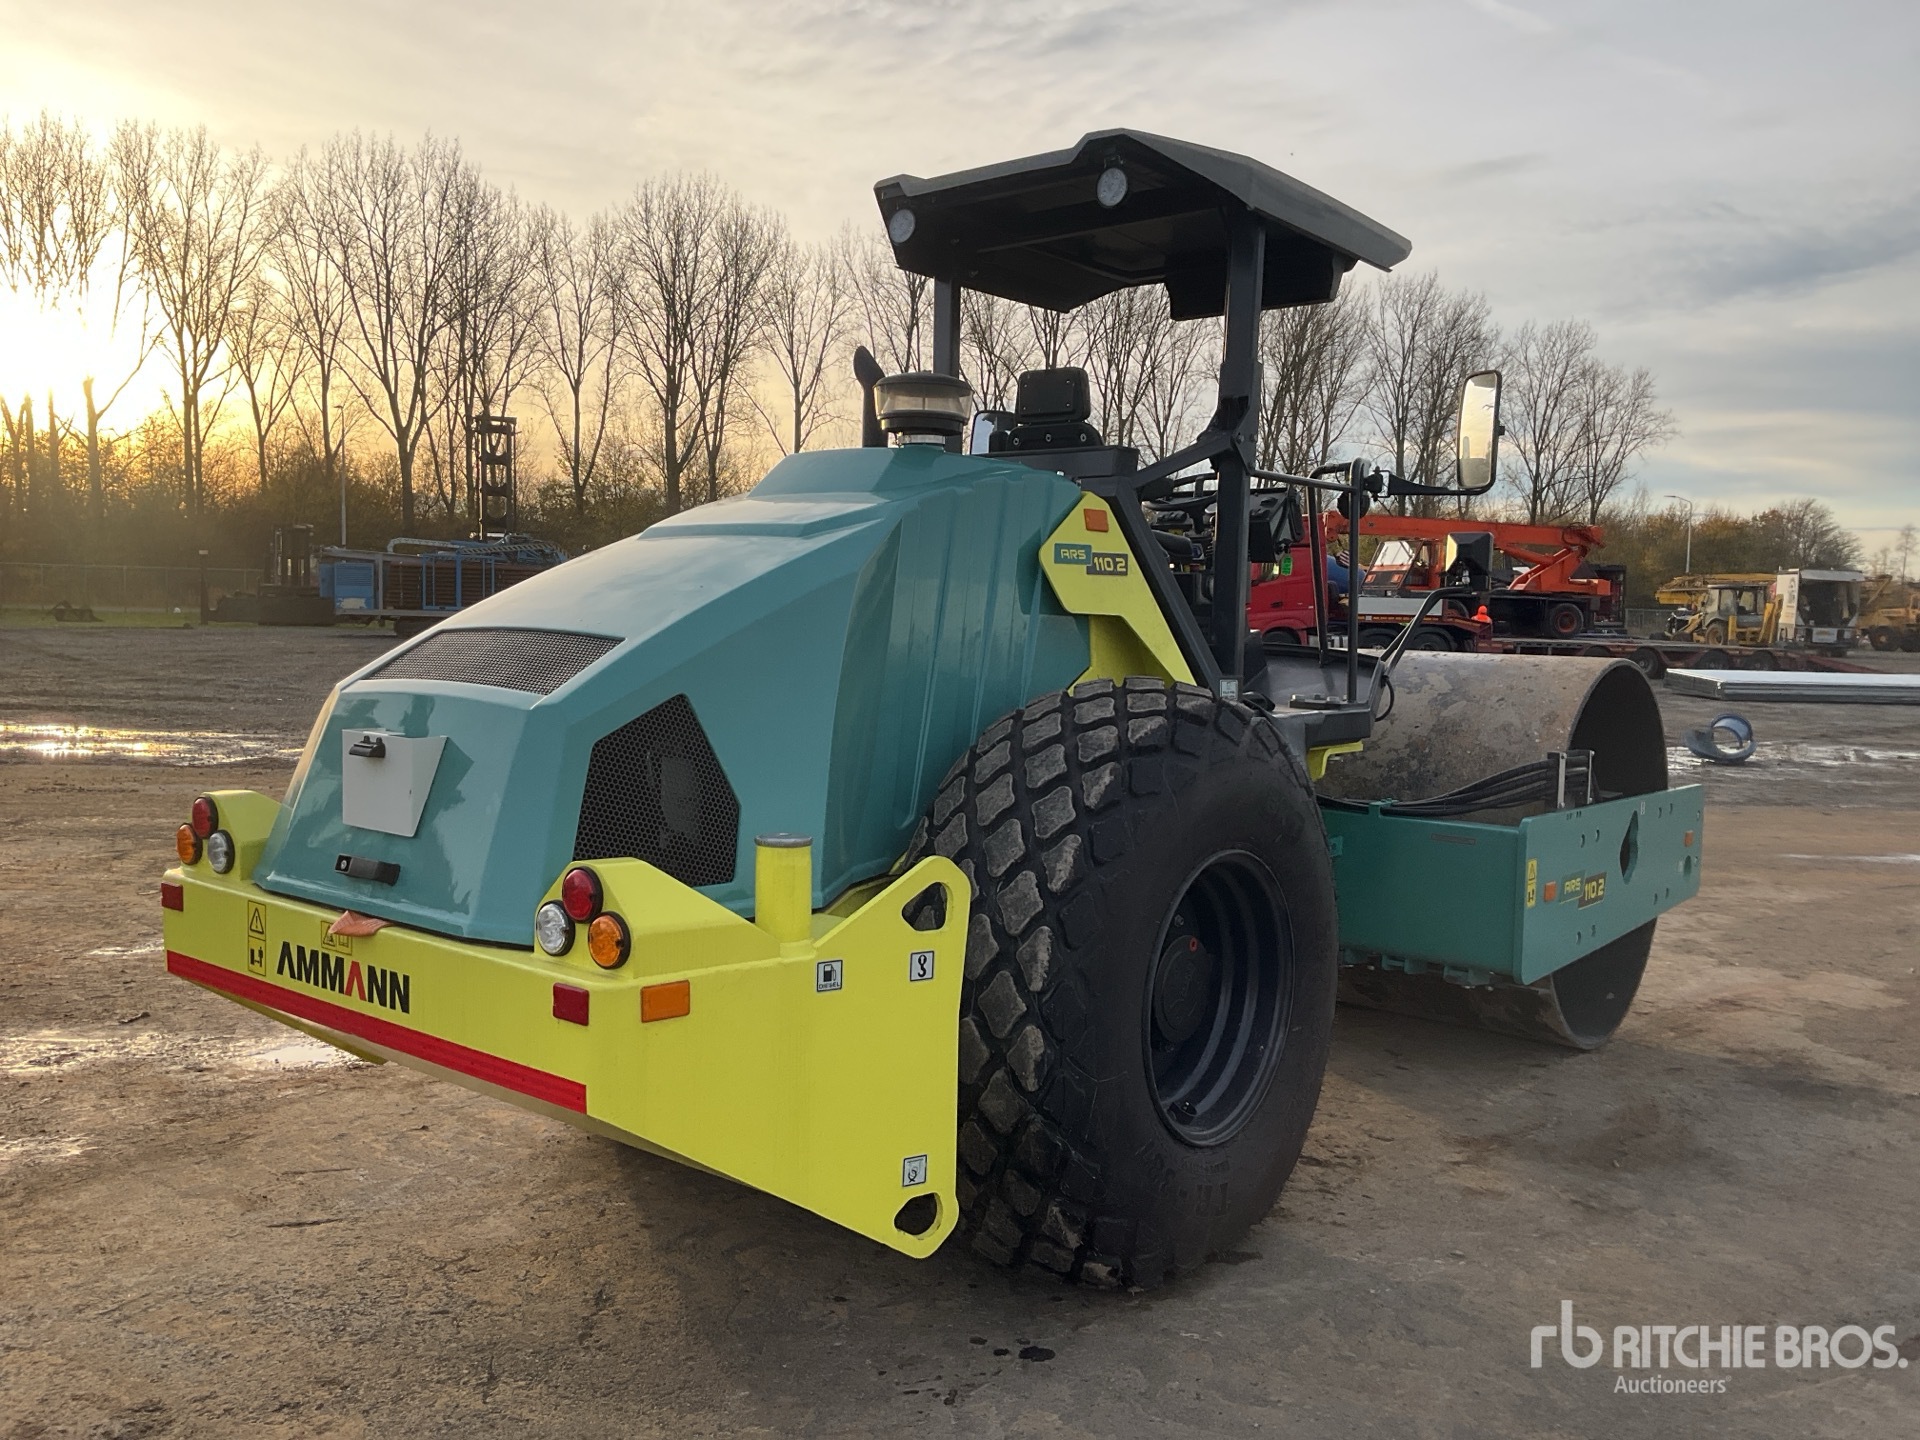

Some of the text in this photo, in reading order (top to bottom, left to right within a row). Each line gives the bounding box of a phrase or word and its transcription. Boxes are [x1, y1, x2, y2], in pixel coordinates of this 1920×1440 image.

[1060, 548, 1086, 560] ARS
[1564, 877, 1581, 894] ARS
[276, 940, 410, 1014] AMMANN
[819, 981, 840, 989] DIESEL
